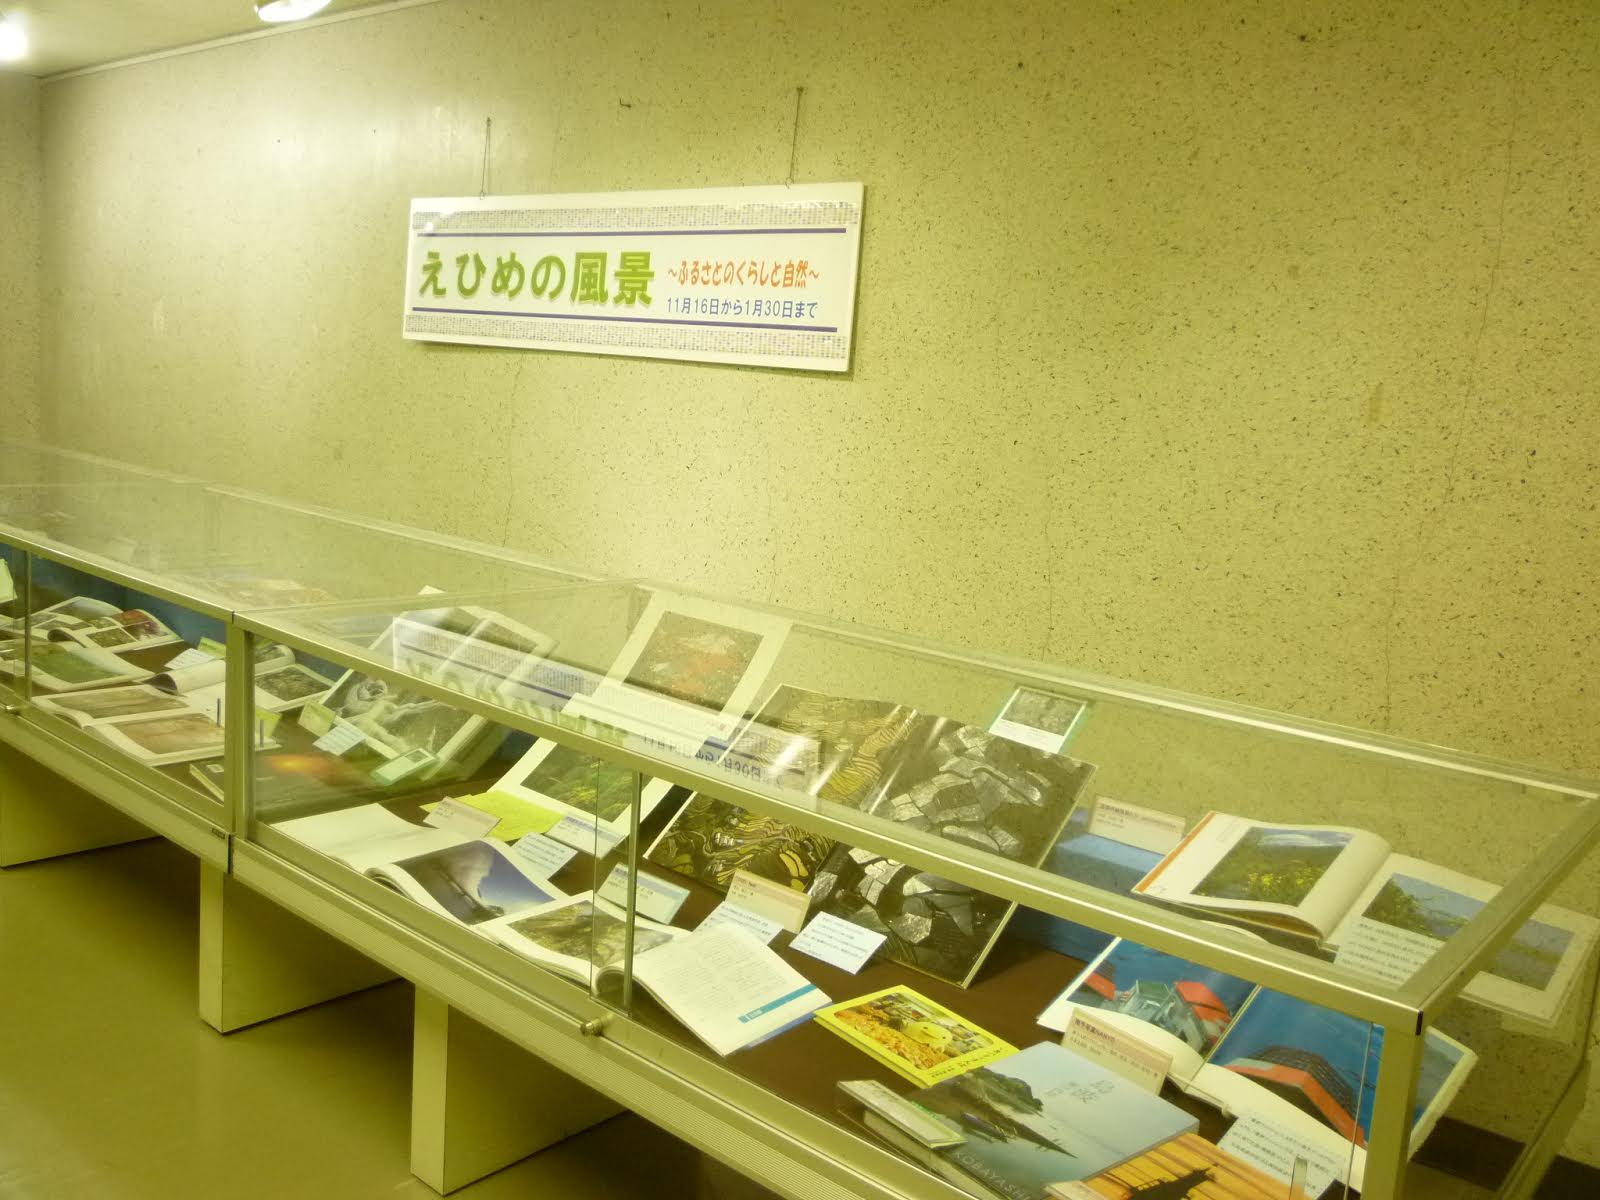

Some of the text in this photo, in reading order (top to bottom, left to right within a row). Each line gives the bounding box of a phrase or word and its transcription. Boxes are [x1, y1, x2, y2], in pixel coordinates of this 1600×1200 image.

[419, 251, 655, 305] えひめの風景
[667, 297, 818, 318] 11月16日から1月30日まで
